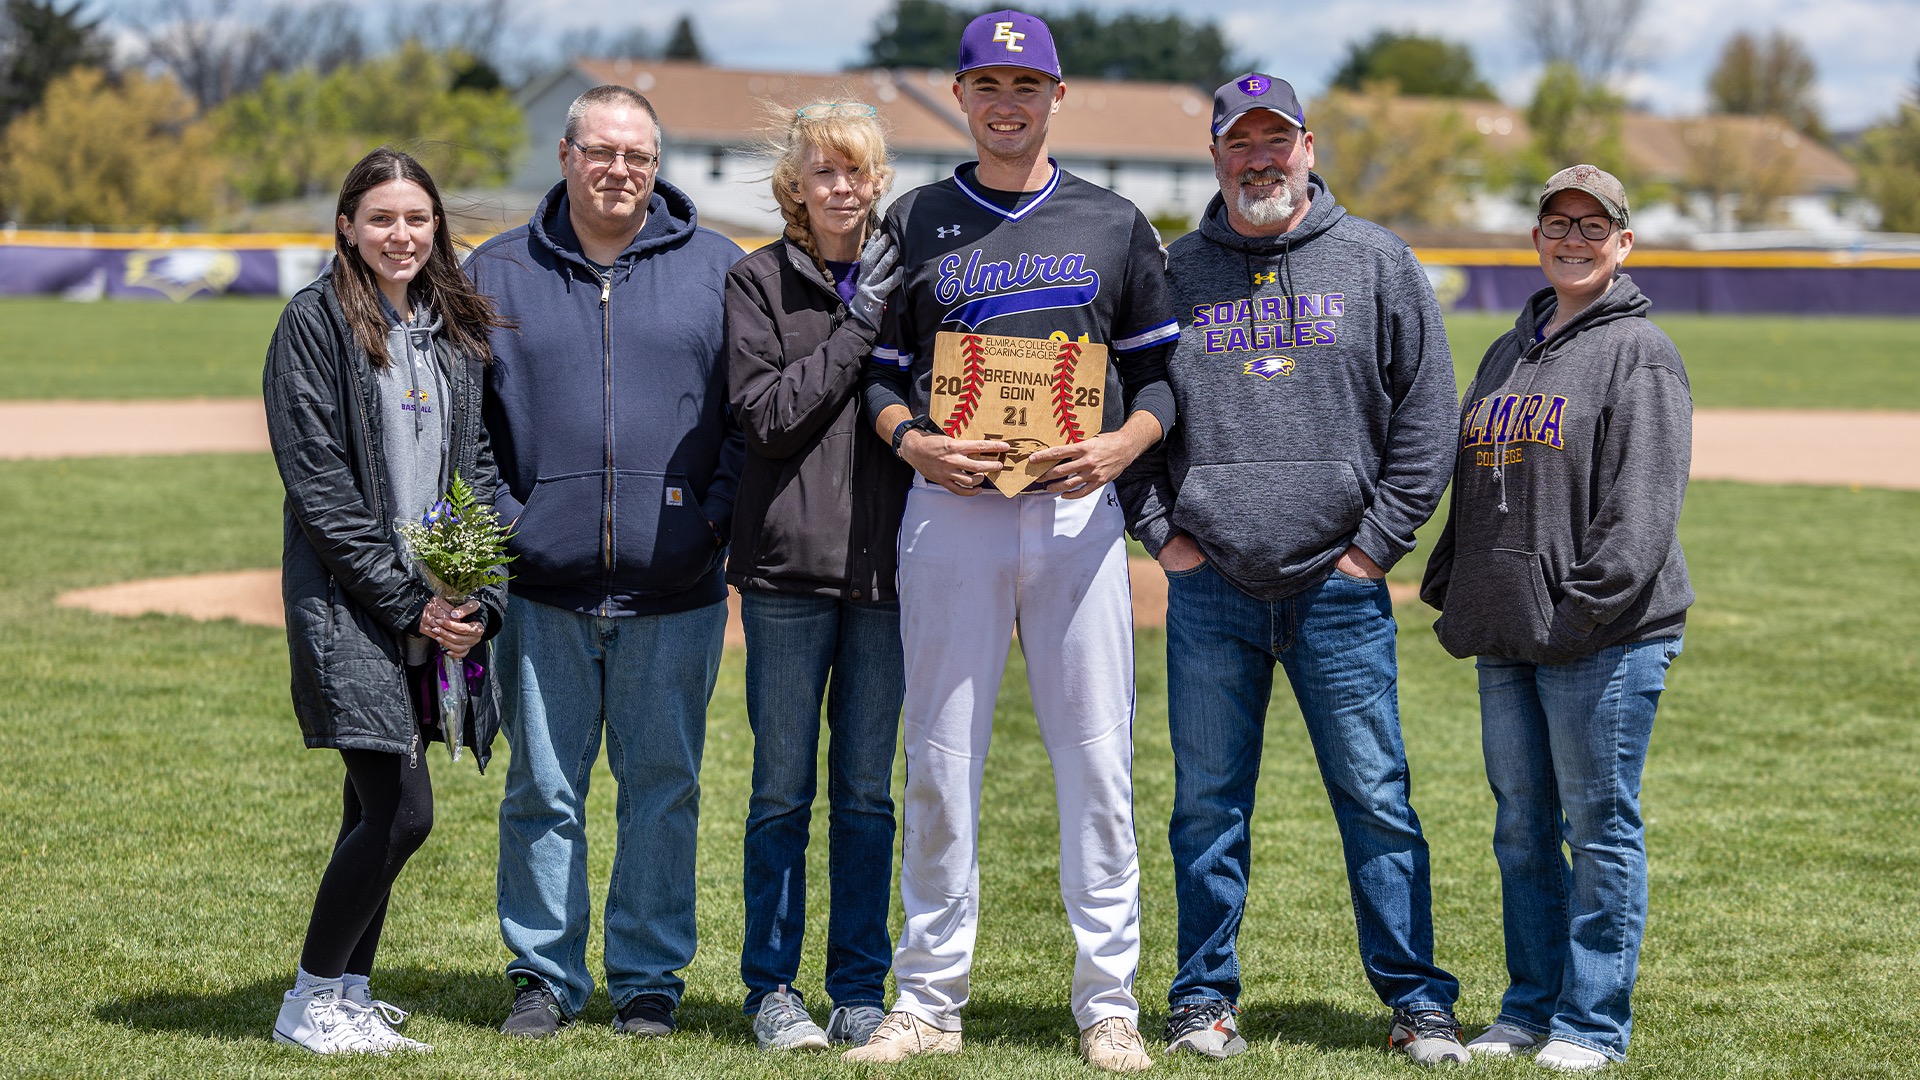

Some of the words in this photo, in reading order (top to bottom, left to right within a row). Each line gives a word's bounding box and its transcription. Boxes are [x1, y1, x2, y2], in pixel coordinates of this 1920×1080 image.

[993, 21, 1025, 52] EC
[1247, 79, 1261, 91] E
[935, 249, 1088, 305] Elmira
[1192, 293, 1345, 329] SOARING
[985, 337, 1016, 349] ELMIRA
[1018, 339, 1058, 351] COLLEGE
[1204, 321, 1337, 354] EAGLES
[984, 346, 1024, 358] SOARING
[1026, 349, 1058, 360] EAGLES
[934, 375, 962, 396] 20
[984, 368, 1054, 387] BRENNAN
[1000, 386, 1035, 401] GOIN
[1075, 386, 1101, 407] 26
[401, 403, 432, 413] BASALL
[1003, 406, 1027, 427] 21
